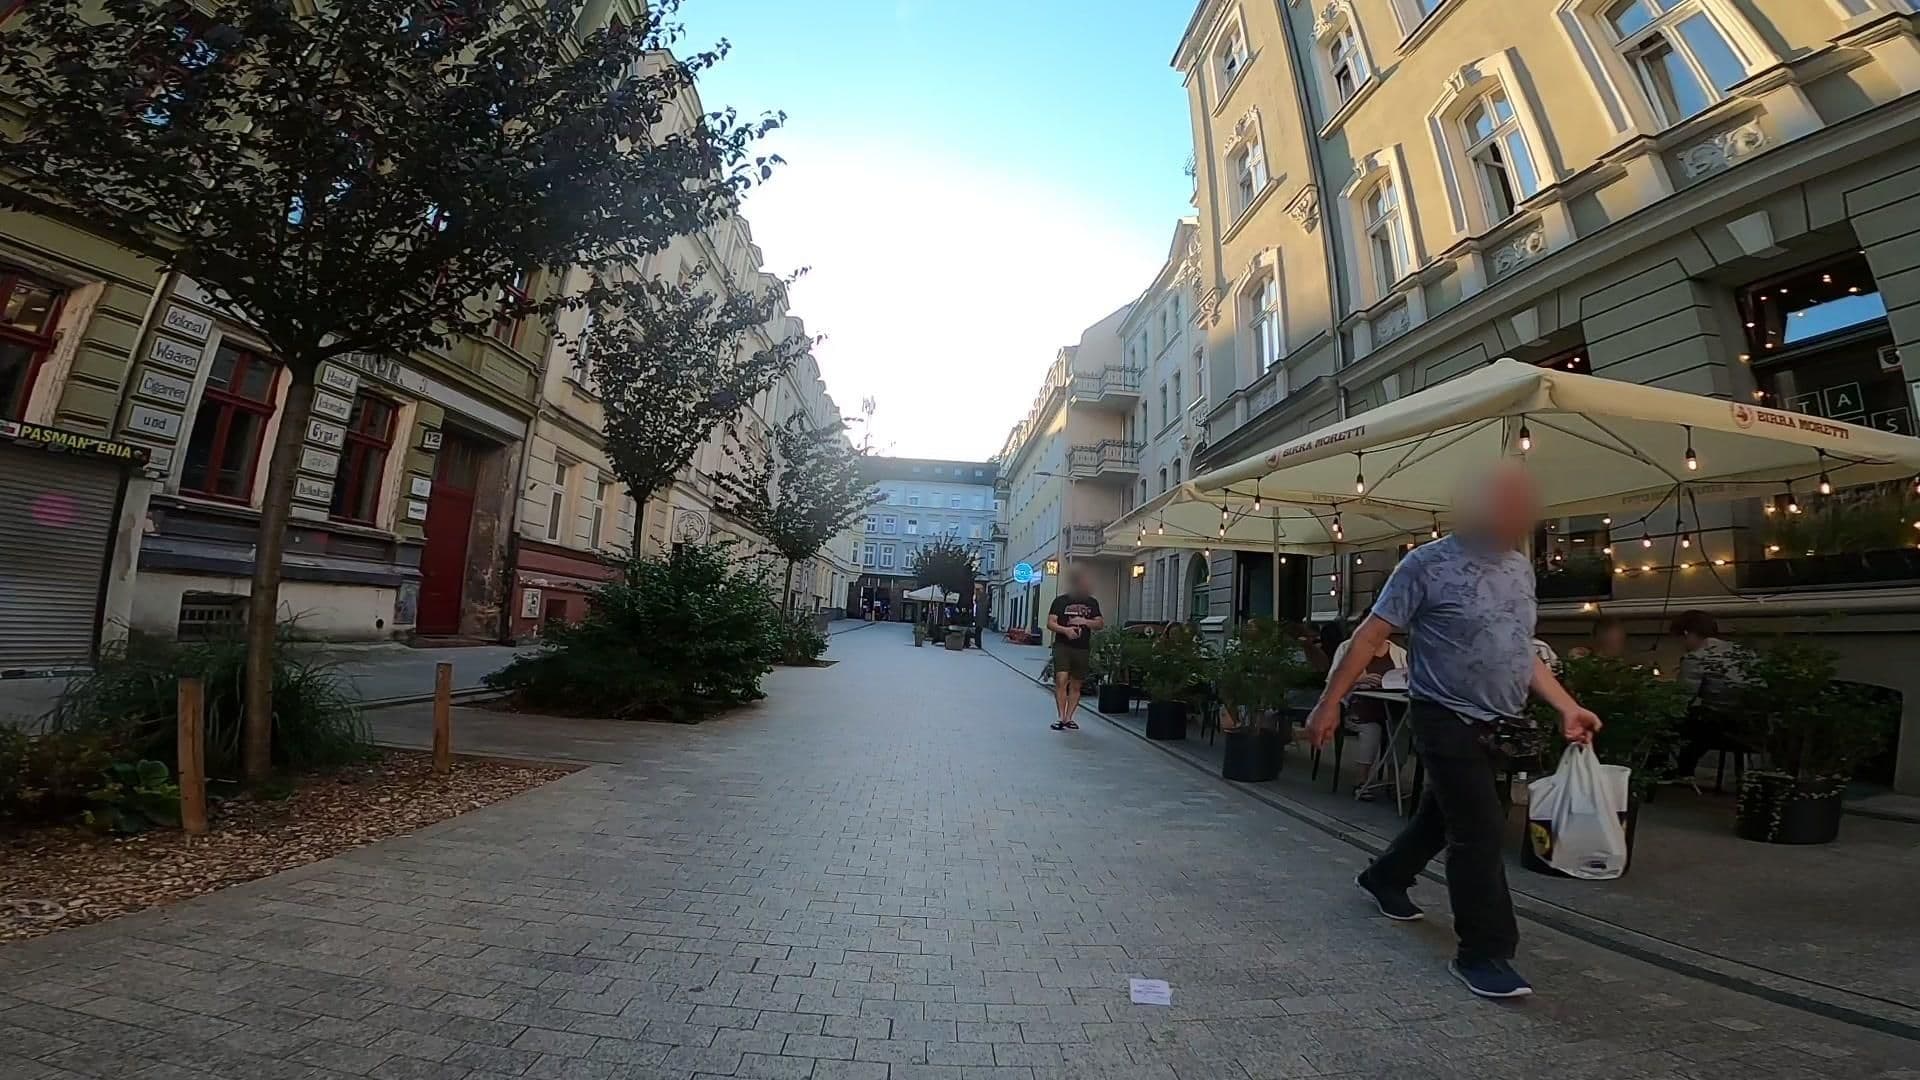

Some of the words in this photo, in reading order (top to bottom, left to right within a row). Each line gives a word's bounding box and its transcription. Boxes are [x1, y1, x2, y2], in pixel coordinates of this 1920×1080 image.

[143, 416, 167, 430] und
[1757, 411, 1797, 428] BIRRA
[1798, 418, 1849, 439] MORETTI
[428, 432, 440, 443] 12
[1282, 441, 1312, 457] BIRRA
[1314, 424, 1365, 449] MORETTI
